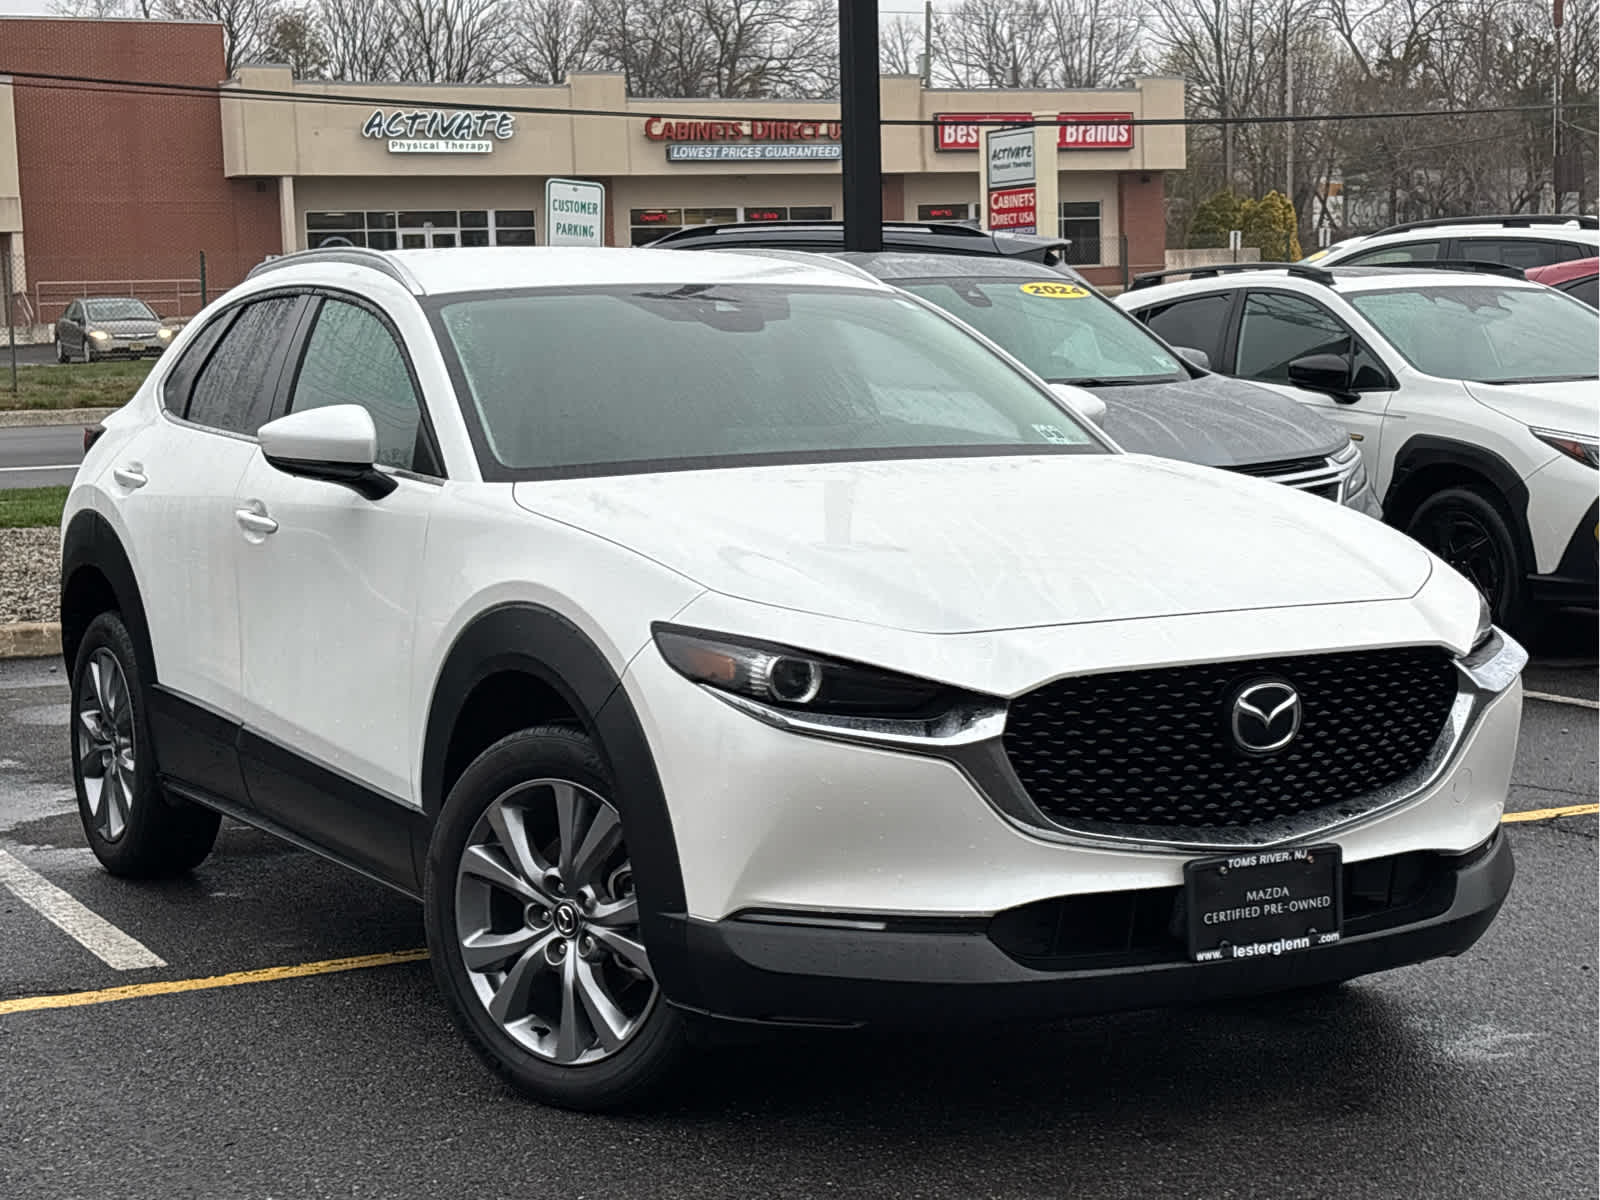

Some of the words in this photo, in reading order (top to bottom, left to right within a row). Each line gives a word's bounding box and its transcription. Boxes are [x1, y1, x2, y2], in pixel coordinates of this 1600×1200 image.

[363, 109, 515, 140] ACTIVATE
[644, 117, 743, 141] CABINETS
[752, 120, 821, 140] DIRECT
[1065, 120, 1128, 143] Brands
[391, 140, 440, 150] Physical
[444, 140, 490, 151] Therapy
[673, 147, 719, 158] LOWEST
[721, 147, 761, 158] PRICES
[765, 146, 840, 158] GUARANTEED
[552, 198, 598, 215] CUSTOMER
[991, 192, 1034, 210] CABINETS
[991, 213, 1017, 226] DIRECT
[1018, 211, 1035, 224] USA
[555, 222, 594, 238] PARKING
[1028, 285, 1085, 295] 2024
[1227, 857, 1257, 869] TOMS
[1294, 850, 1307, 860] NJ
[1246, 886, 1290, 902] MAZDA
[1203, 906, 1261, 925] CERTIFIED
[1263, 896, 1331, 916] PRE-OWNED
[1232, 936, 1310, 958] lesterglenn
